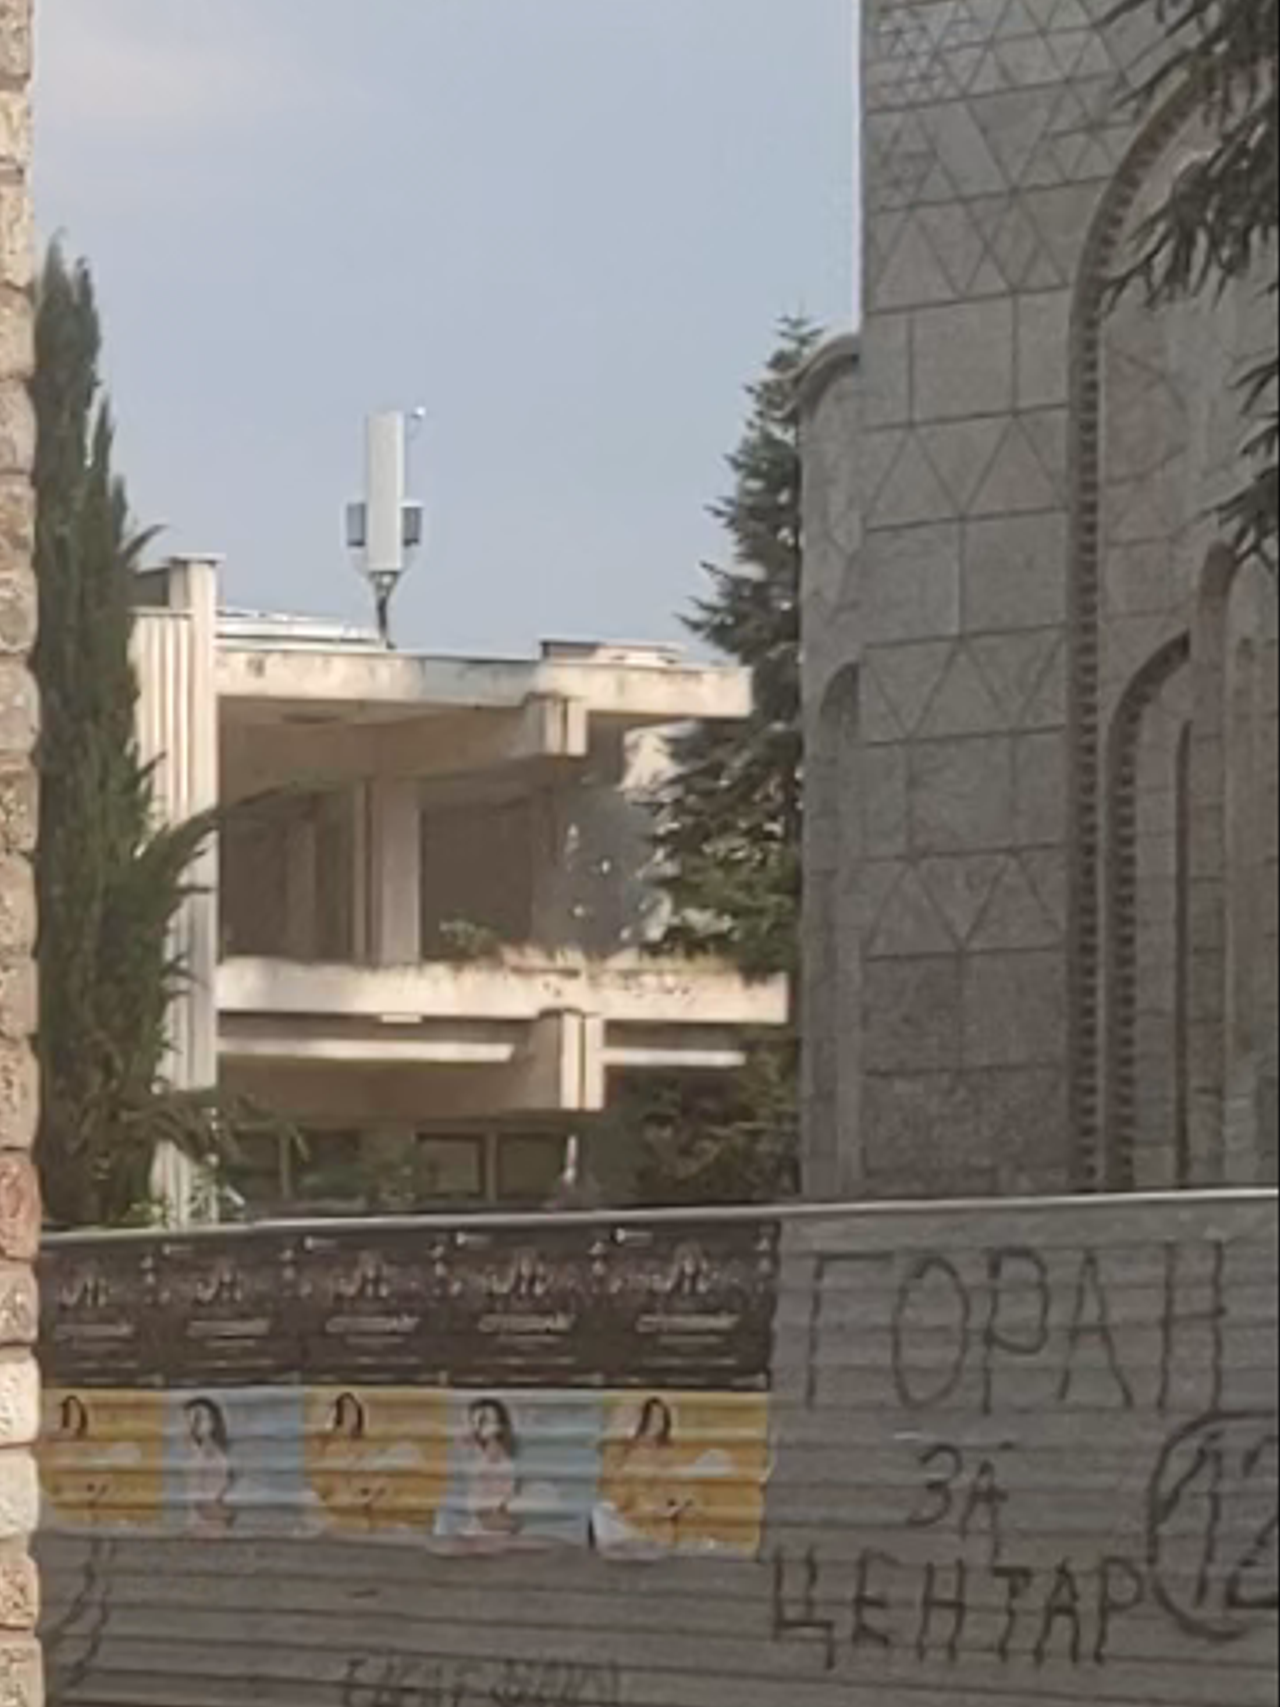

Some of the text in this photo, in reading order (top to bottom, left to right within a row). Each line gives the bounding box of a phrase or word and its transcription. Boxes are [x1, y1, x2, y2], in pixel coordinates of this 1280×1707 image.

[804, 1238, 1228, 1417] ГОРАН
[906, 1441, 1010, 1559] ЗА
[771, 1545, 1145, 1671] ЦЕНТАР
